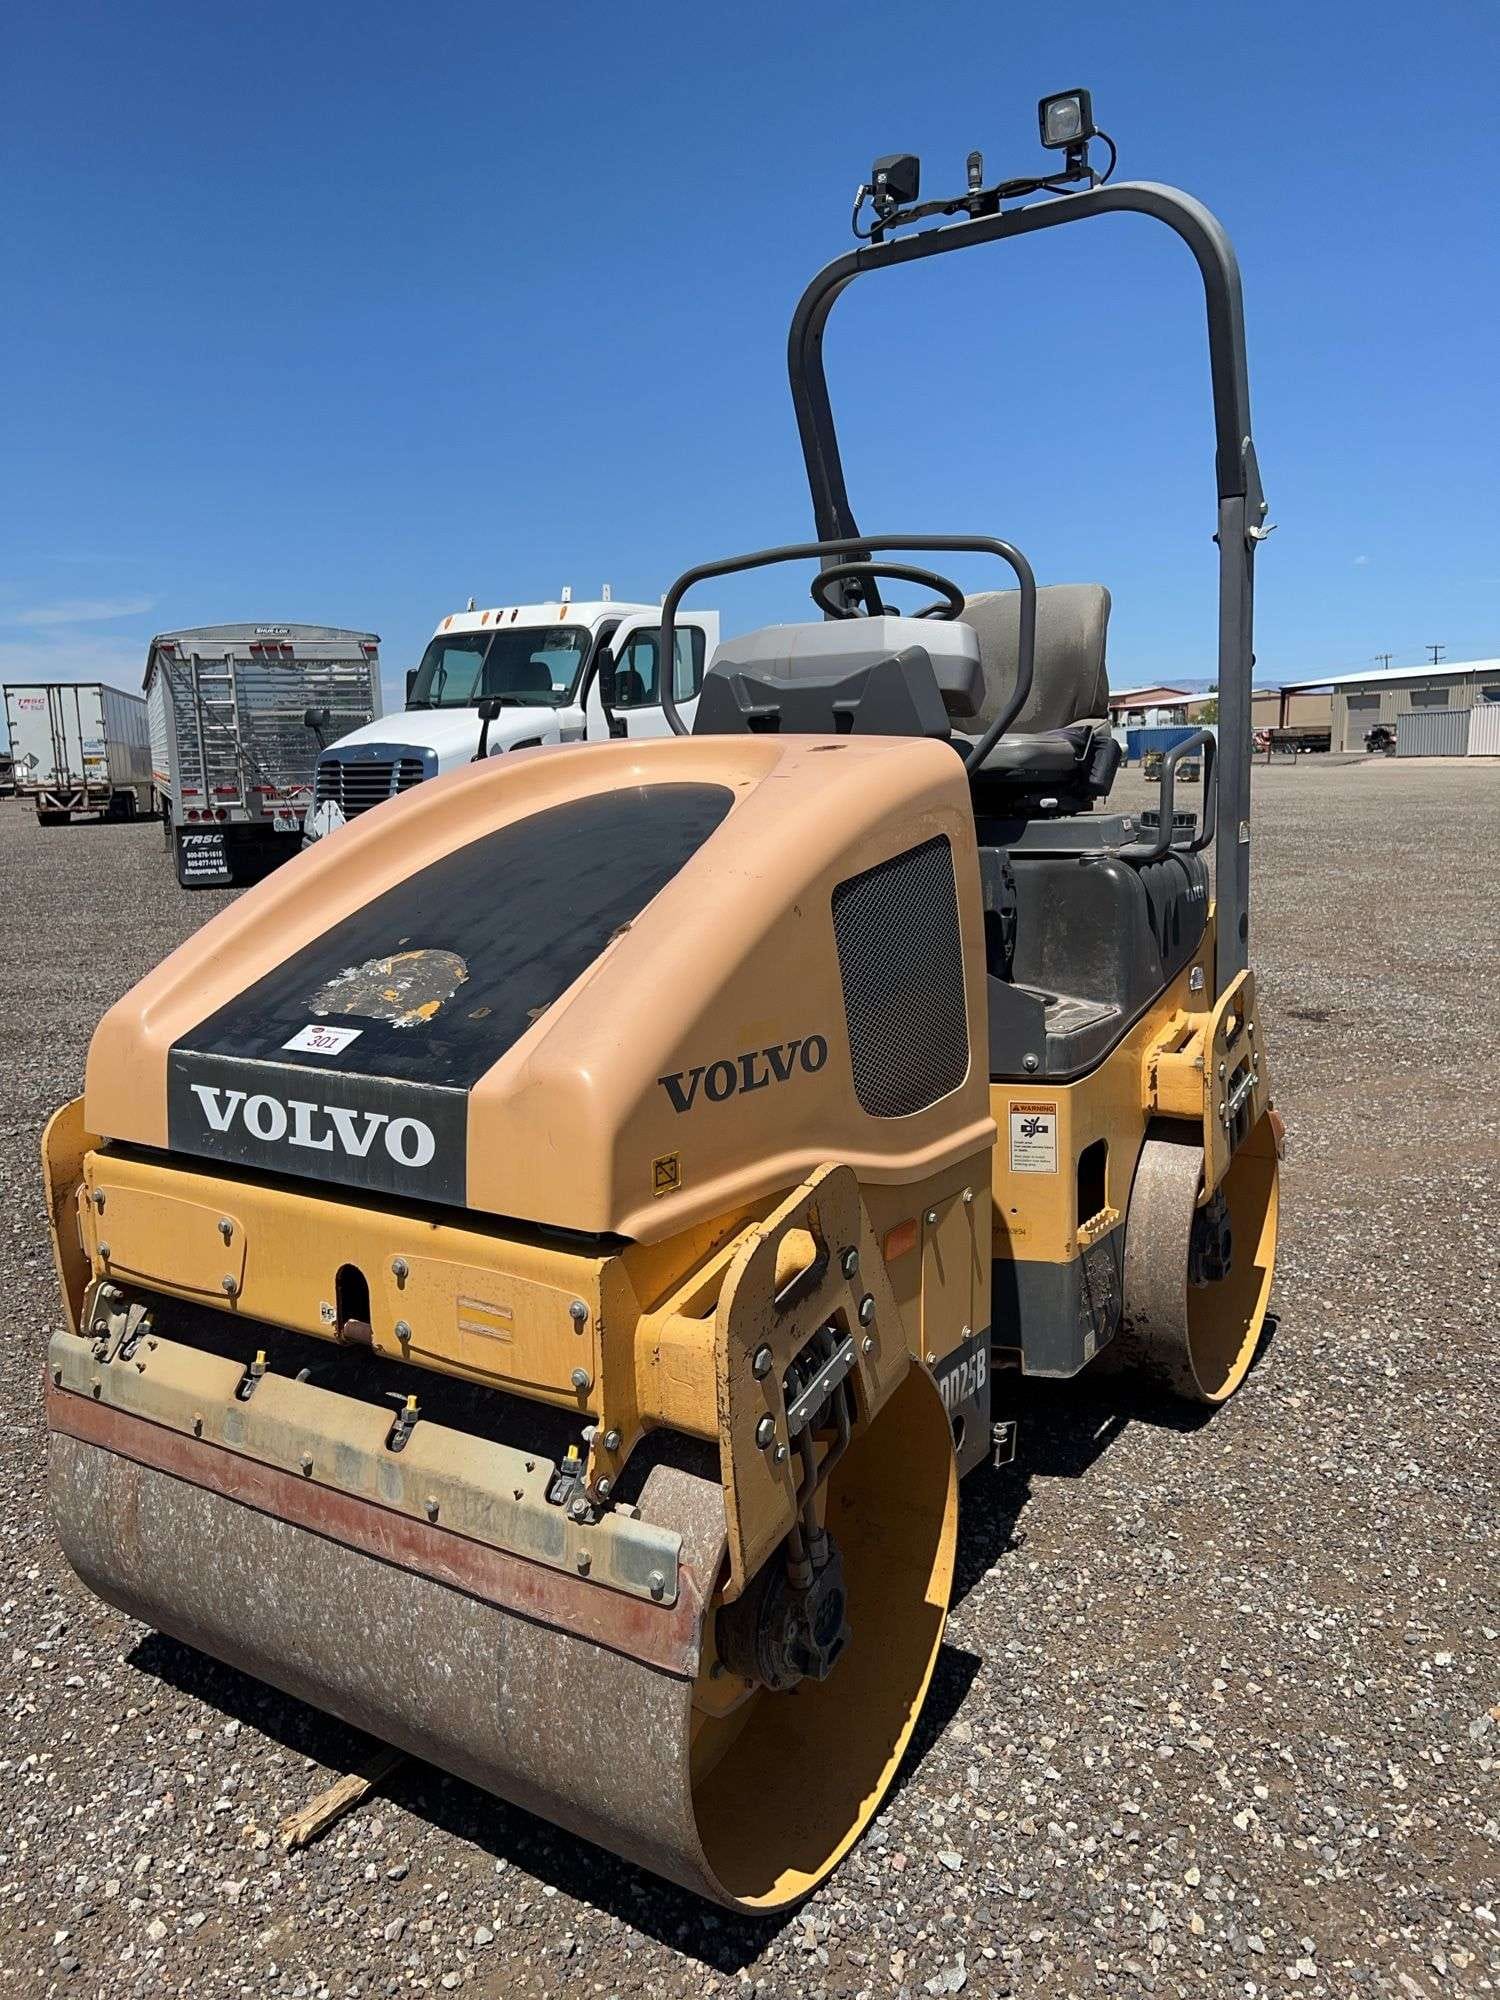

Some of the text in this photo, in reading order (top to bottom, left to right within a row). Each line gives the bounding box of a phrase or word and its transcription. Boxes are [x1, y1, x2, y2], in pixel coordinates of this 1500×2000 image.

[181, 834, 224, 848] TASC
[306, 1035, 340, 1050] 301
[657, 1033, 829, 1114] VOLVO
[190, 1083, 436, 1168] VOLVO
